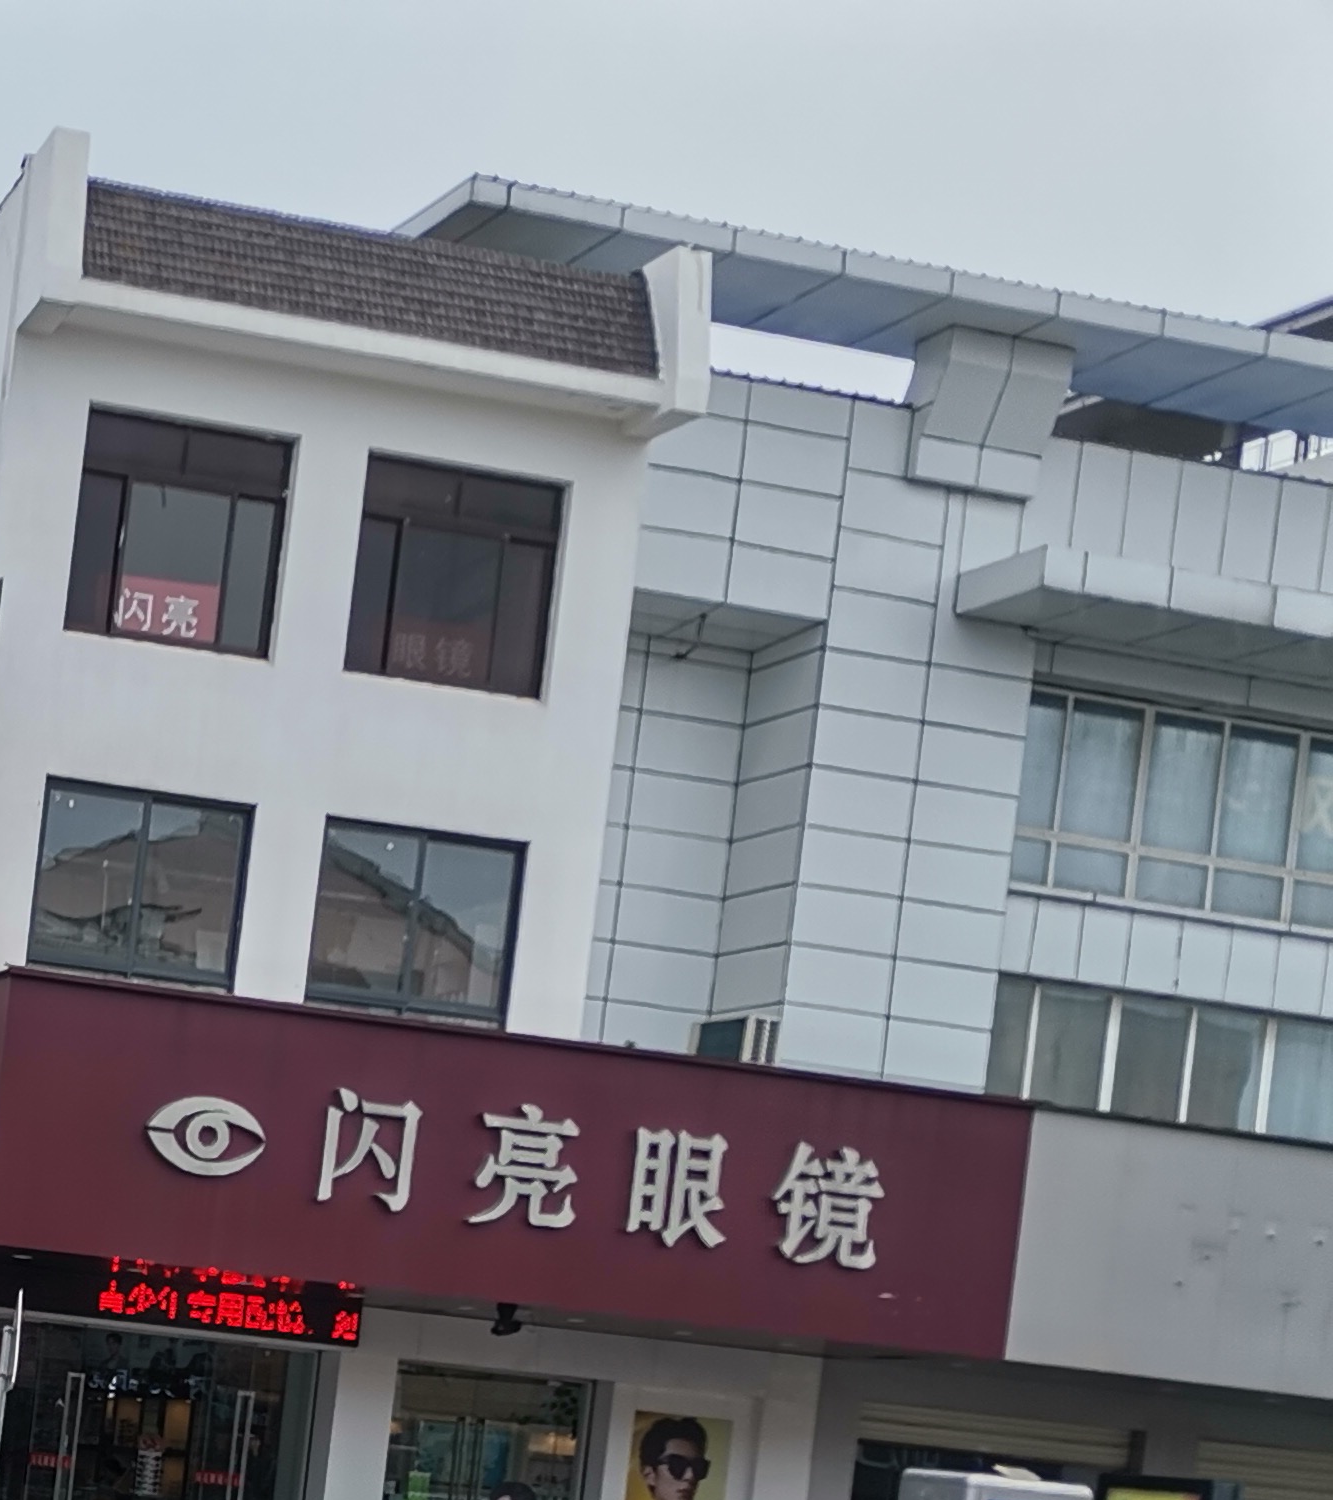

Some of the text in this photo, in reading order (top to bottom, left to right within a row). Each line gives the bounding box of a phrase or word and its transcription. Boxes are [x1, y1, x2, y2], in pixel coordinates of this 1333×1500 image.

[114, 587, 199, 638] 闪亮
[315, 1086, 886, 1270] 闪亮眼镜
